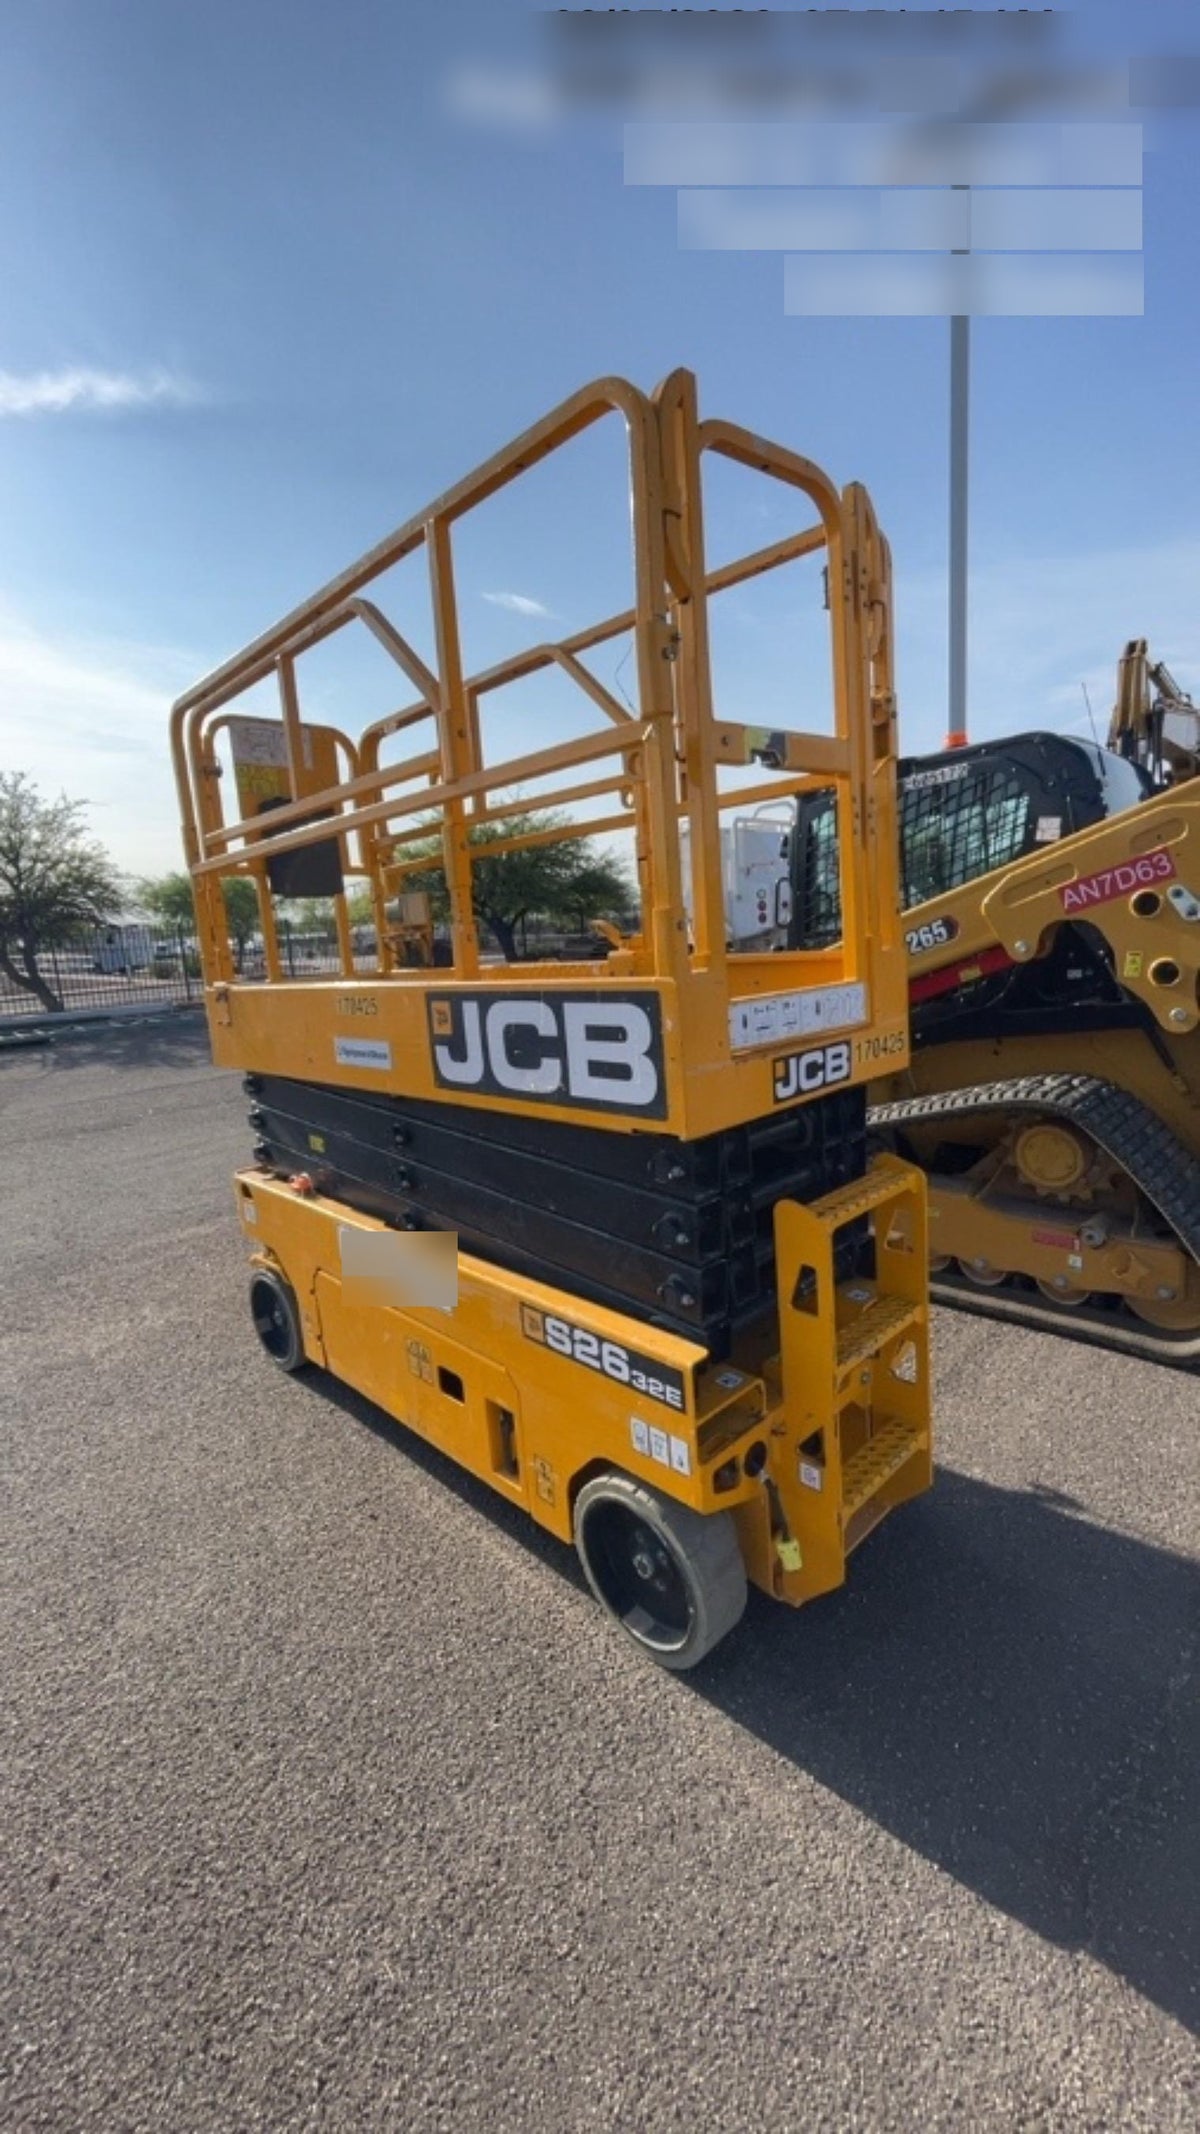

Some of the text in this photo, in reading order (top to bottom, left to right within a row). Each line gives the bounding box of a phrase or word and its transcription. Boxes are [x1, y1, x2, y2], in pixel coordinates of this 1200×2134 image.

[1063, 853, 1173, 909] AN7D63
[905, 919, 948, 953] 265
[435, 1000, 658, 1105] JCB
[775, 1043, 850, 1099] JCB
[857, 1031, 905, 1062] 170425
[545, 1316, 630, 1382] S26
